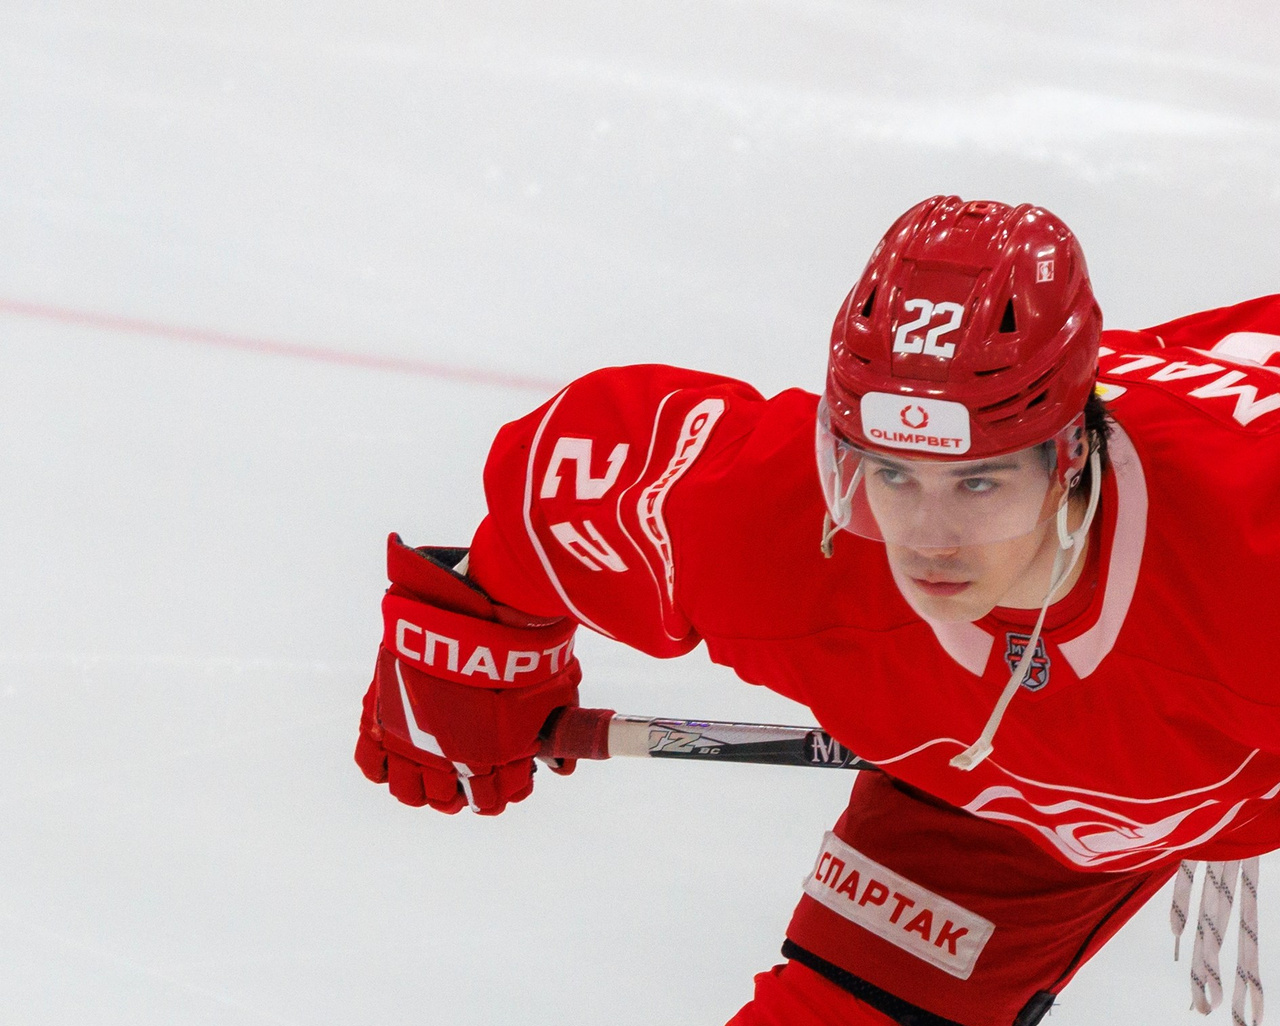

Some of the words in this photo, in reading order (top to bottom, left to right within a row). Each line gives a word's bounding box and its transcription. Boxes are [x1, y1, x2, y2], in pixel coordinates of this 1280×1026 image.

[893, 298, 965, 359] 22
[870, 427, 963, 449] OLIMPBET
[540, 436, 630, 573] 22
[814, 850, 969, 956] СПАРТАК
